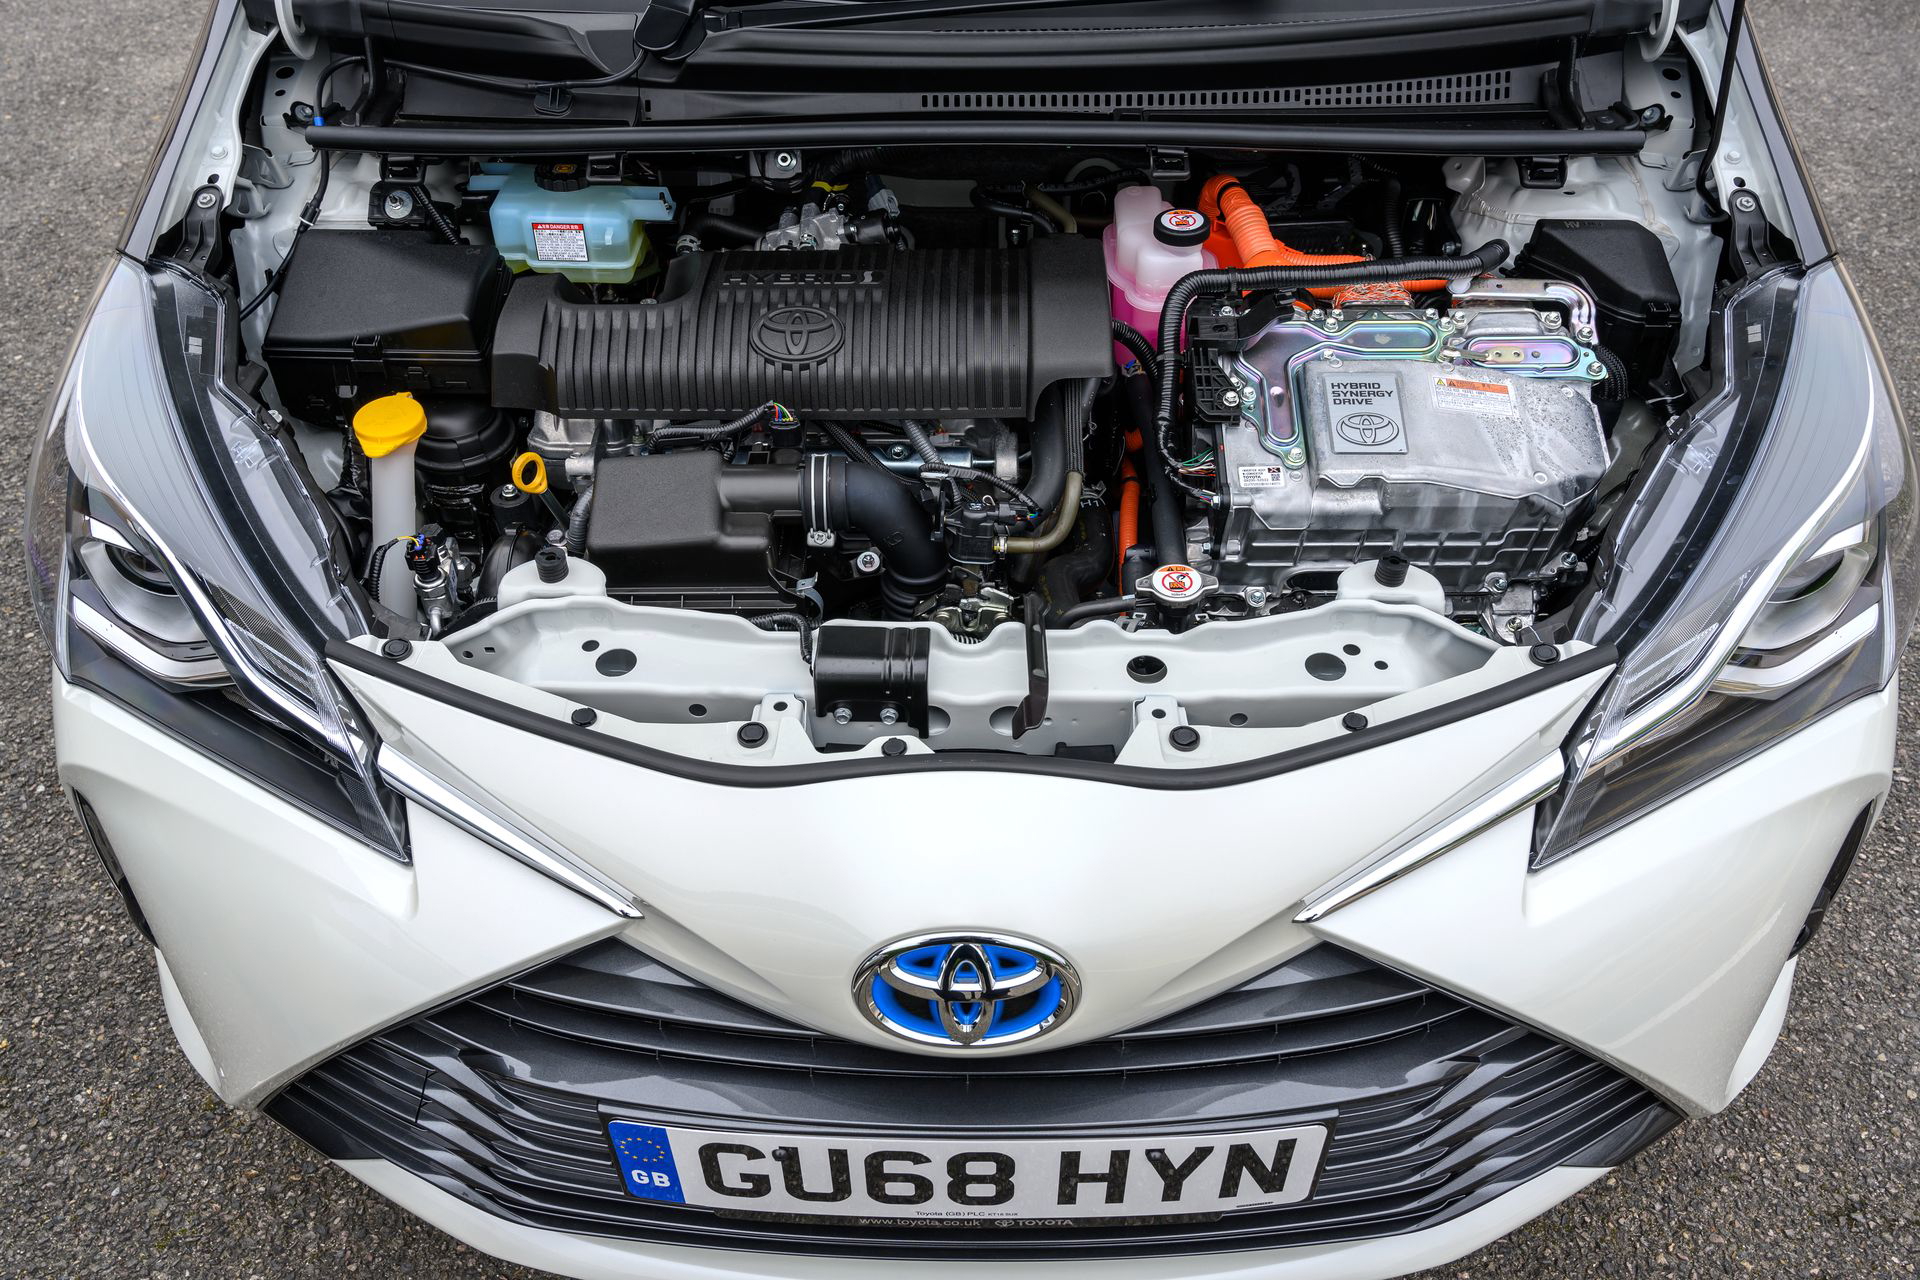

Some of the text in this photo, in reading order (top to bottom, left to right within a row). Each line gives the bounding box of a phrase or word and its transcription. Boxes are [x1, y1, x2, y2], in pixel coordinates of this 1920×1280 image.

[1331, 382, 1381, 390] HYBRID
[1332, 390, 1394, 398] SYNERGY
[1333, 398, 1374, 406] DRIVE
[698, 1138, 1298, 1206] GU68 HYN
[631, 1169, 671, 1188] GB
[859, 1217, 981, 1227] www.toyota.co.uk
